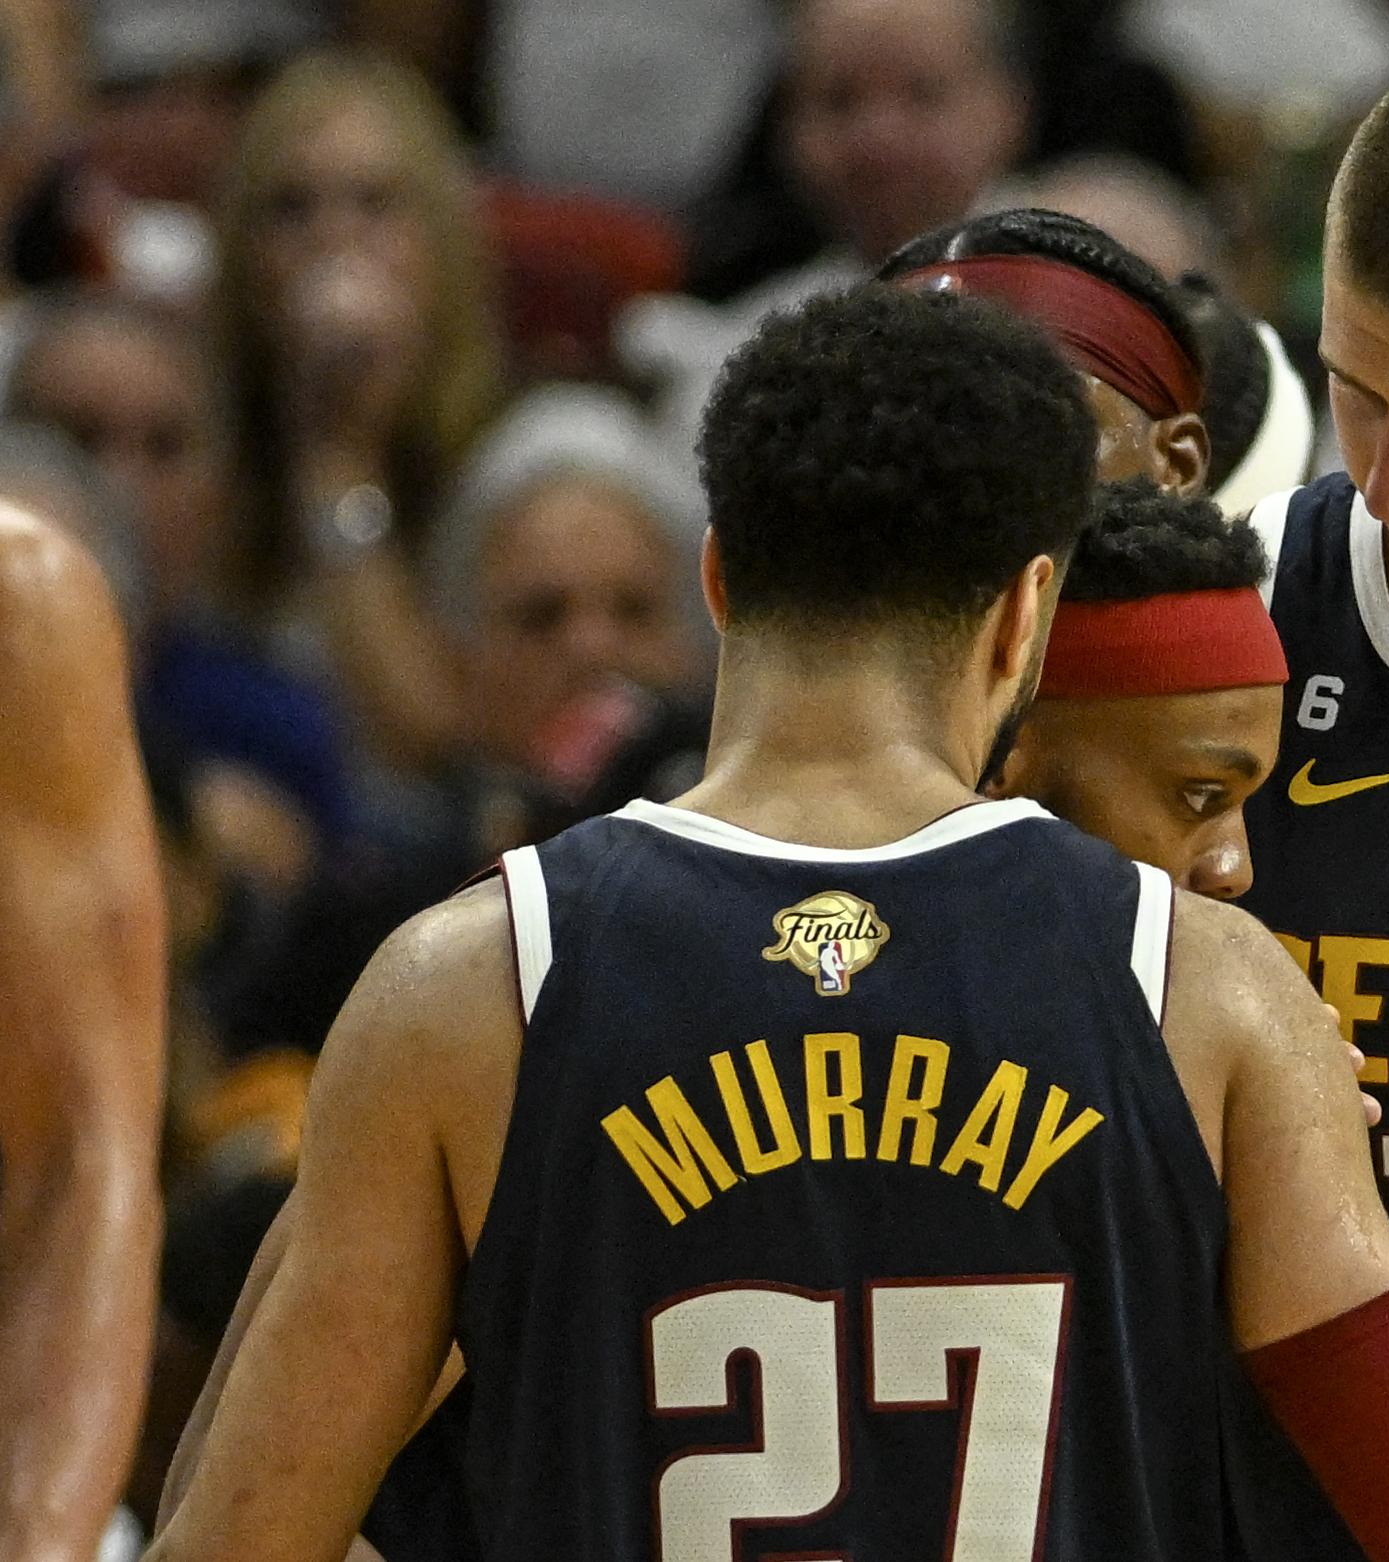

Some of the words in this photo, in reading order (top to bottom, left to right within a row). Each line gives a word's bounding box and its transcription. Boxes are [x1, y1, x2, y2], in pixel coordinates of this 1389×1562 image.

[1297, 674, 1345, 731] 6
[773, 908, 882, 955] Finals
[600, 1032, 1104, 1226] MURRAY
[646, 1273, 1073, 1562] 27
